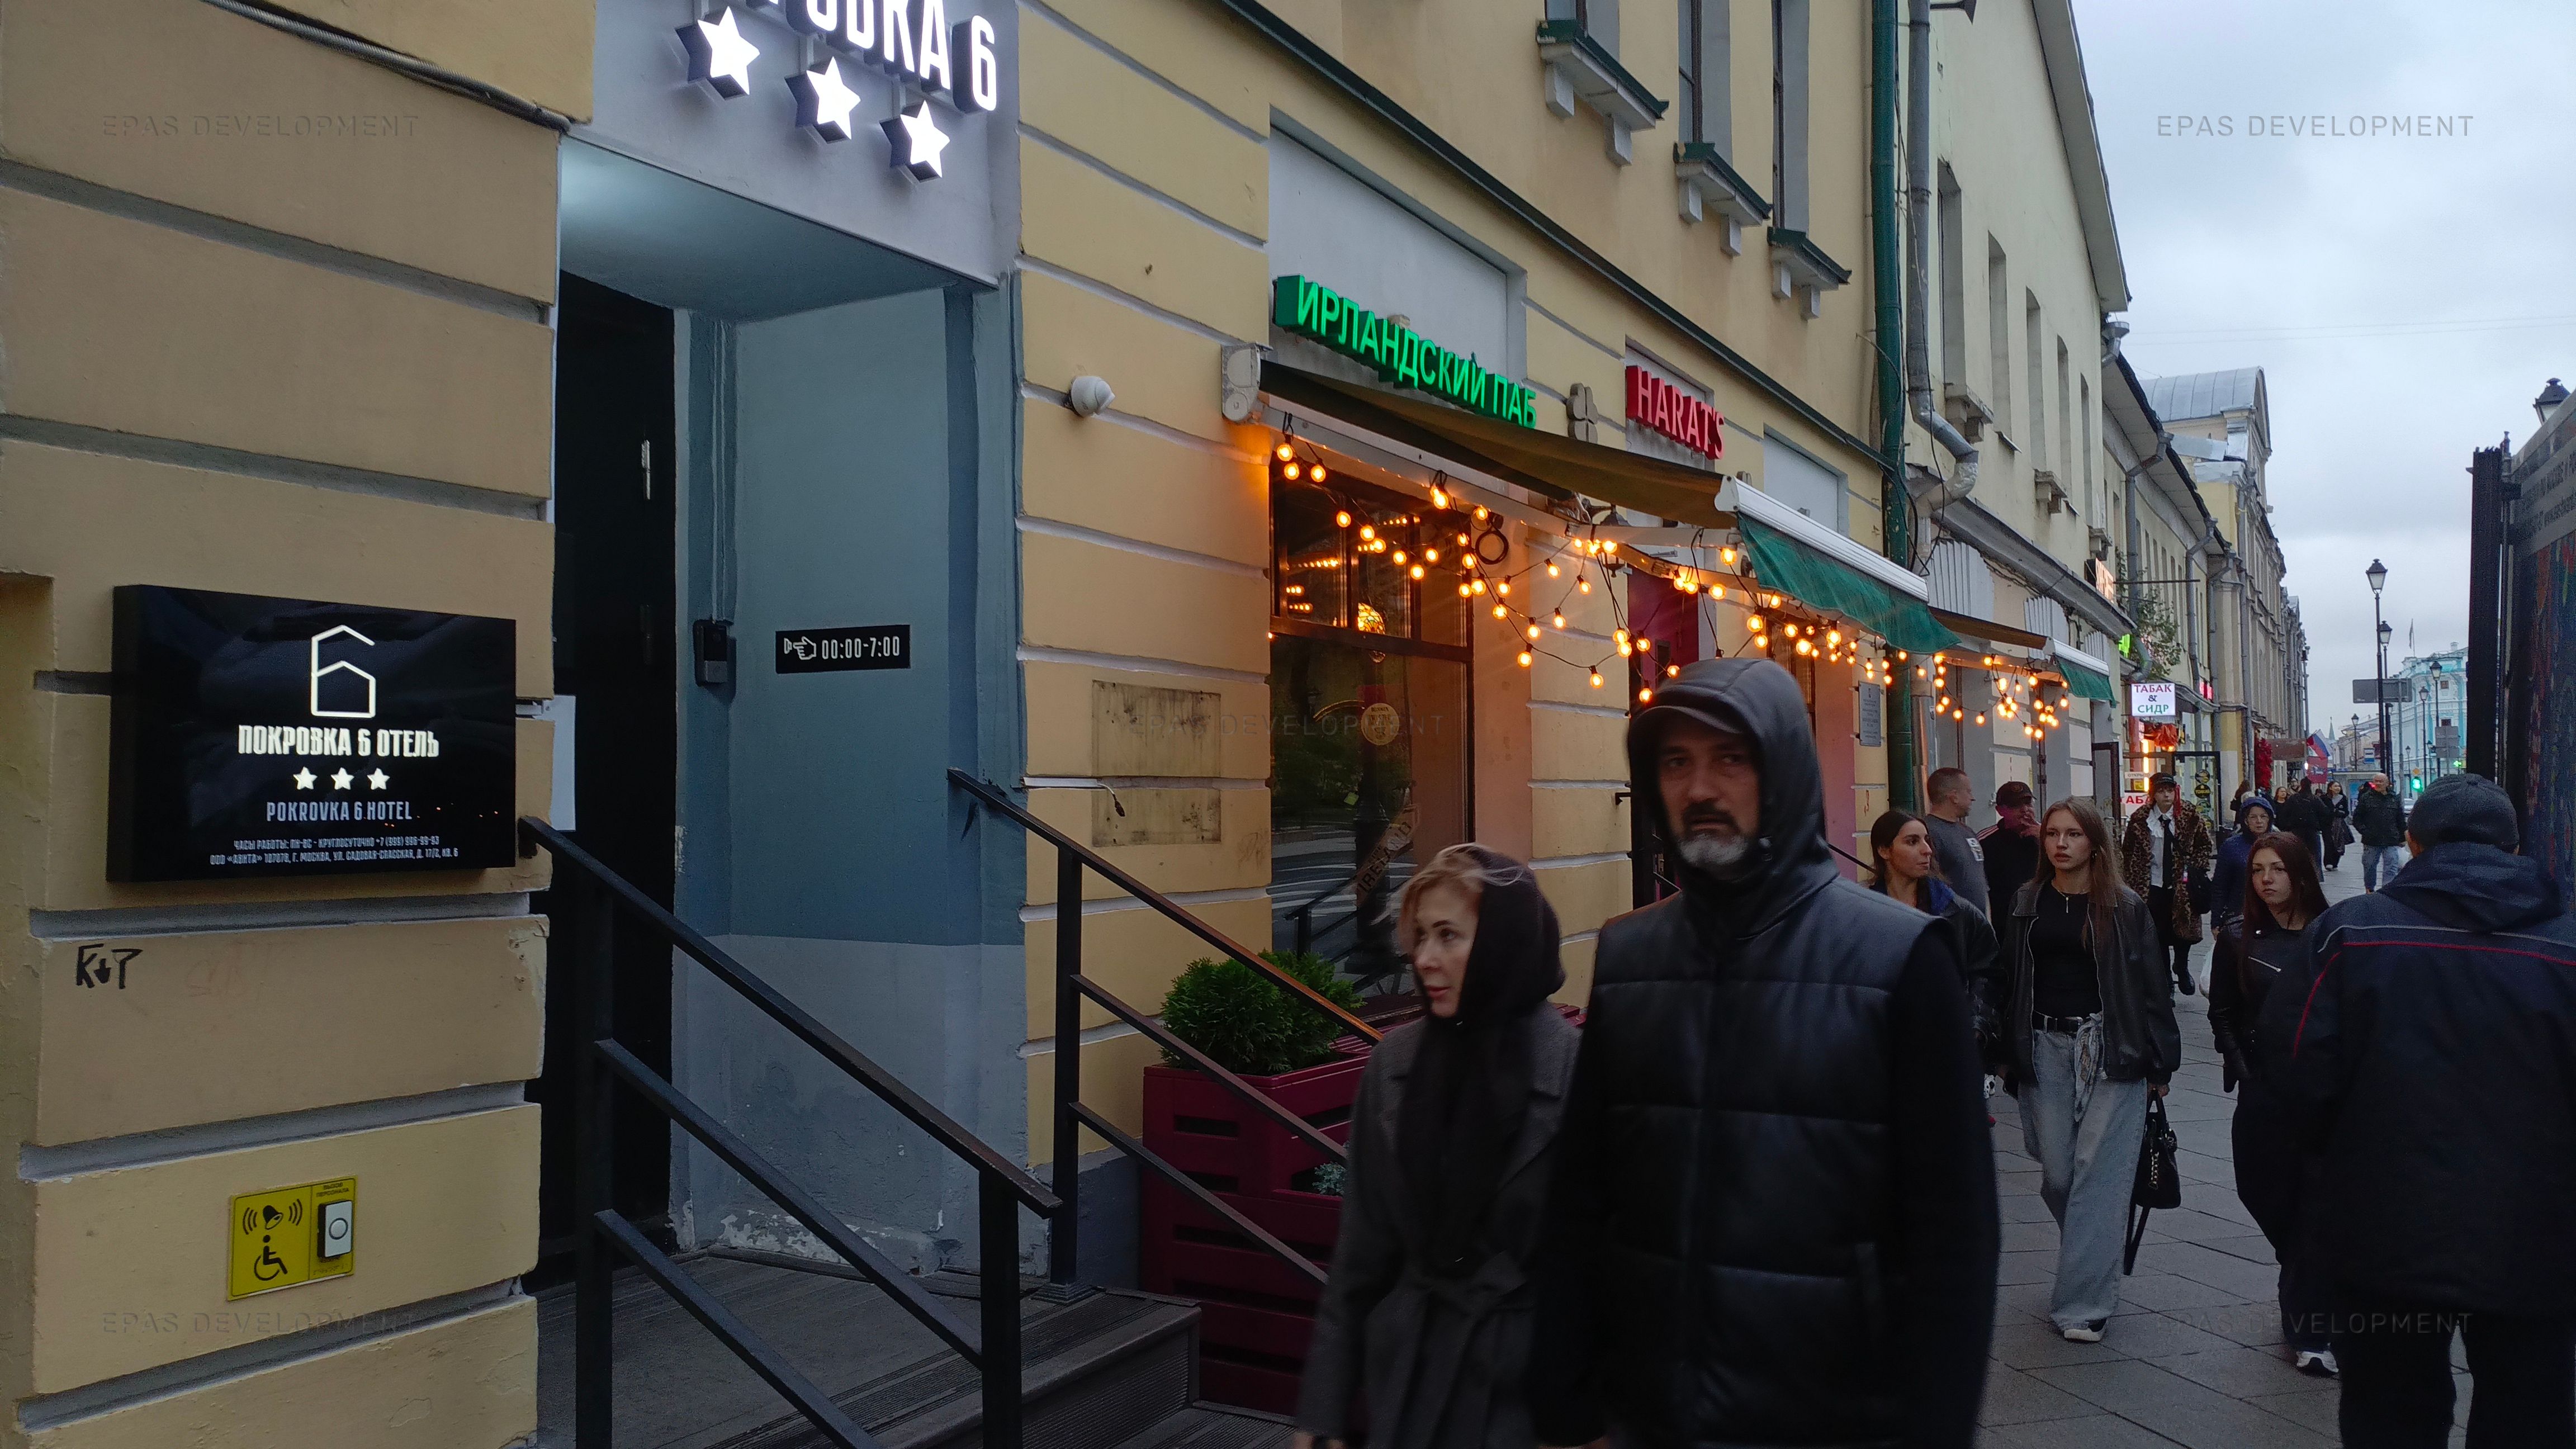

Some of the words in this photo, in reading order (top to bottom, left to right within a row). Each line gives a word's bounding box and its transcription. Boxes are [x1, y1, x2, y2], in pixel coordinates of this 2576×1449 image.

[971, 15, 997, 111] 6
[1297, 274, 1485, 408] ИРЛАНДСКИЙ
[1494, 373, 1536, 429] ПАБ
[1637, 366, 1725, 460] HARAT'S
[821, 636, 900, 660] 00:00-7:00
[2134, 684, 2172, 693] ТАБАК
[2137, 704, 2169, 714] СИДР
[238, 724, 352, 756] ПОКРОВКА
[358, 728, 371, 756] 6
[377, 729, 439, 757] ОТЕЛЬ
[266, 802, 350, 822] POKROVKA
[354, 801, 362, 821] 6
[367, 801, 413, 820] HOTEL
[234, 840, 255, 850] ЧАСЫ
[257, 839, 290, 850] РАБОТЫ:
[318, 837, 375, 848] КРУГЛОСУТОЧНО
[210, 854, 226, 865] ООО
[300, 851, 332, 863] МОСКВА,
[333, 851, 345, 861] УЛ.
[453, 847, 458, 857] 6
